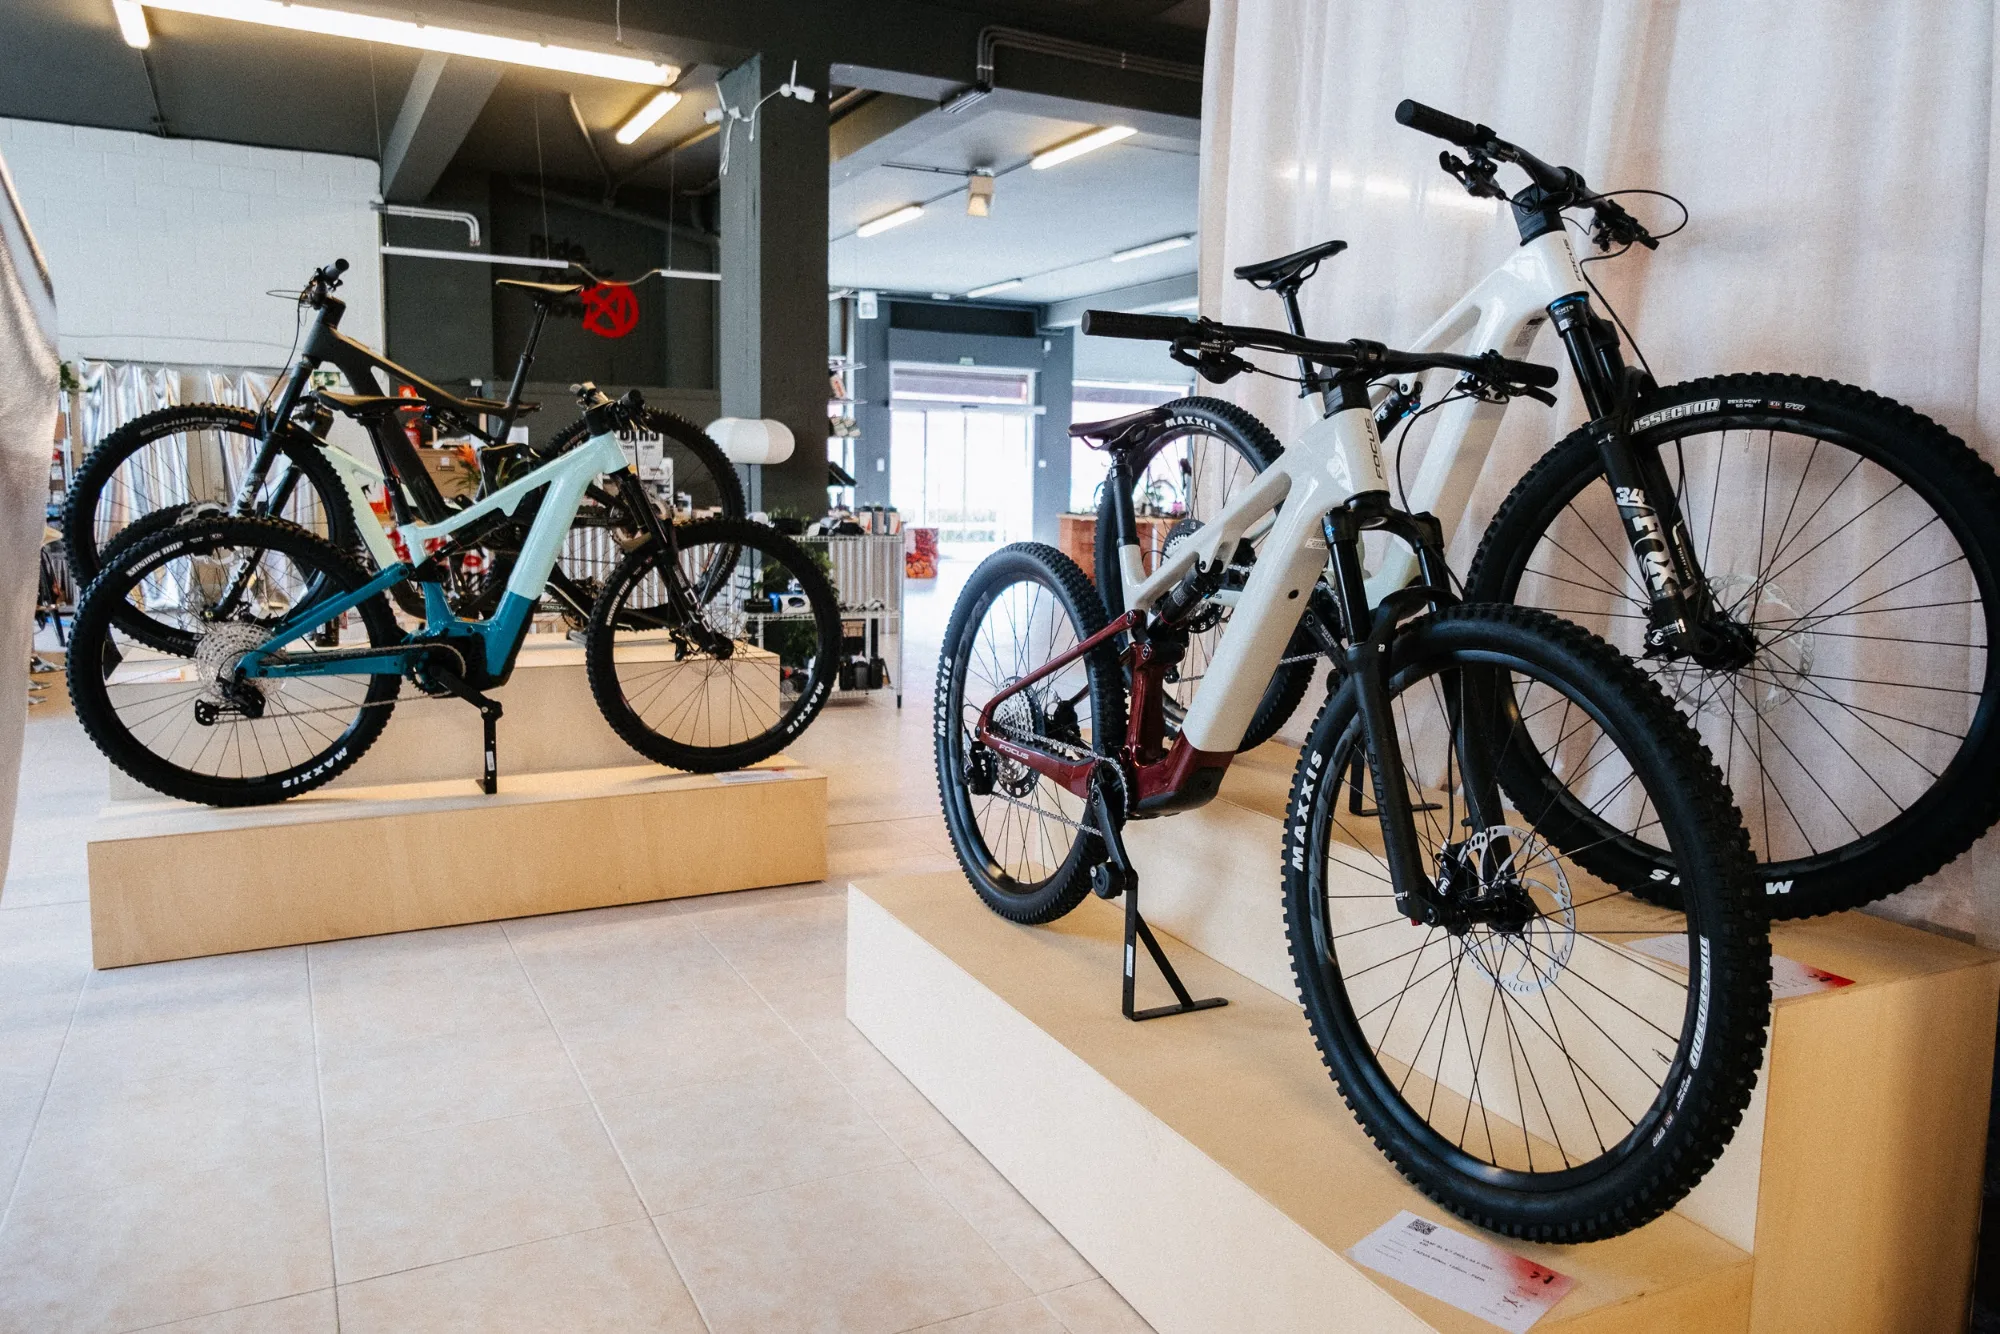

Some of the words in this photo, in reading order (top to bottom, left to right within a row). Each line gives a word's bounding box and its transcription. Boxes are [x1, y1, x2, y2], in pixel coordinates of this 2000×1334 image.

[1165, 415, 1217, 431] MAXXIS
[1364, 417, 1383, 479] FOCUS
[1616, 486, 1646, 504] 34
[786, 681, 825, 734] MAXXIS
[937, 656, 953, 738] MAXXIS
[281, 746, 348, 789] MAXXIS
[999, 743, 1030, 760] FOCUS
[1291, 750, 1323, 872] MAXXIS
